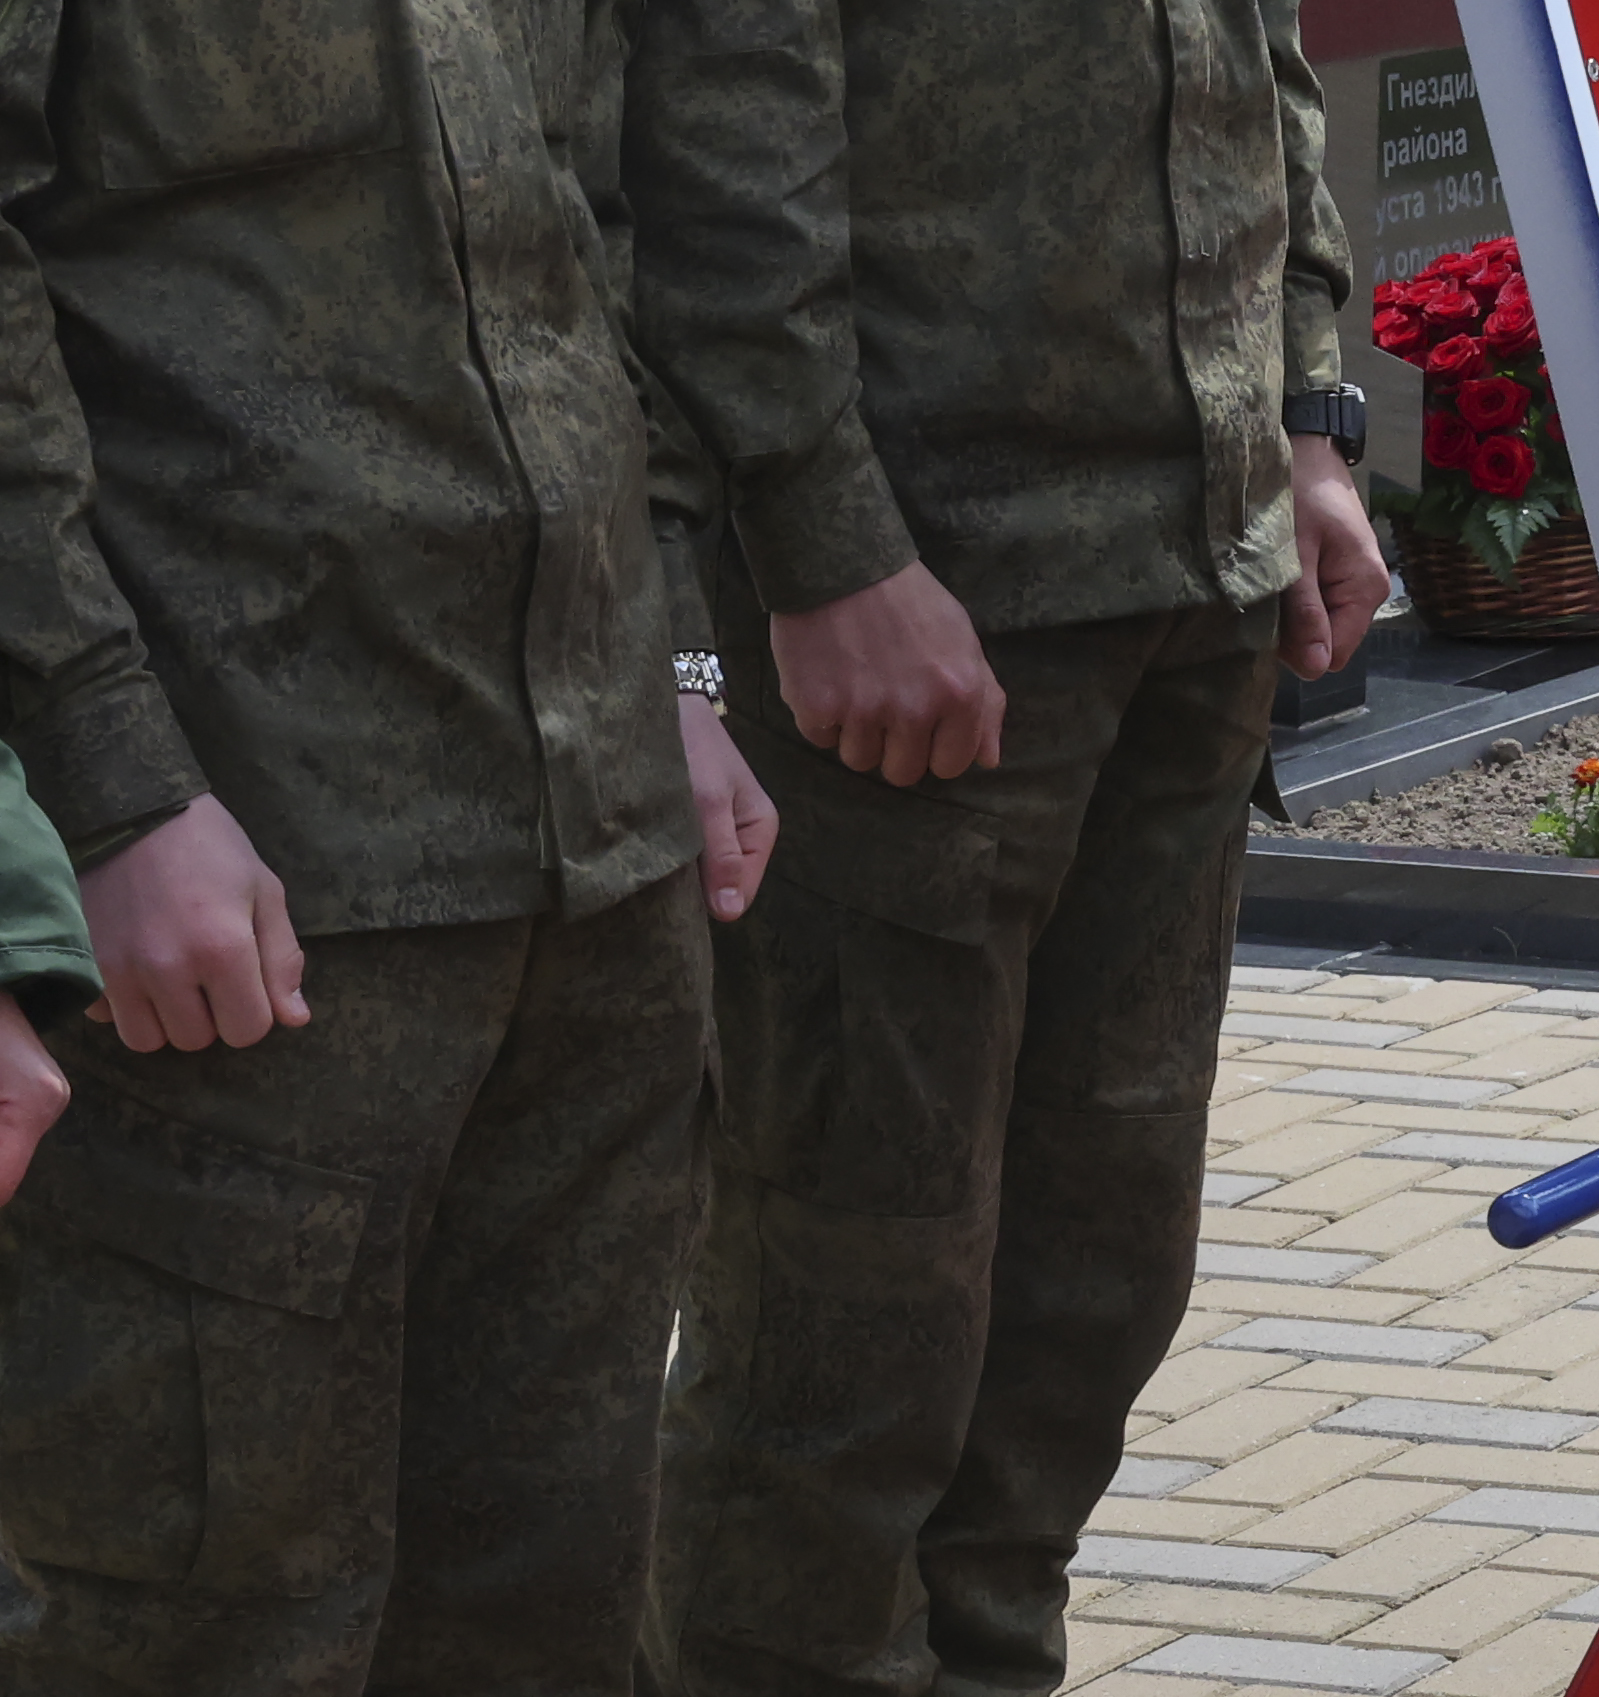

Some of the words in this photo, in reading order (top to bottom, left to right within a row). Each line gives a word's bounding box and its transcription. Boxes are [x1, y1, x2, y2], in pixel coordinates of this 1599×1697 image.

[1383, 126, 1467, 178] района
[1376, 191, 1425, 236] уста
[1434, 170, 1484, 214] 1943
